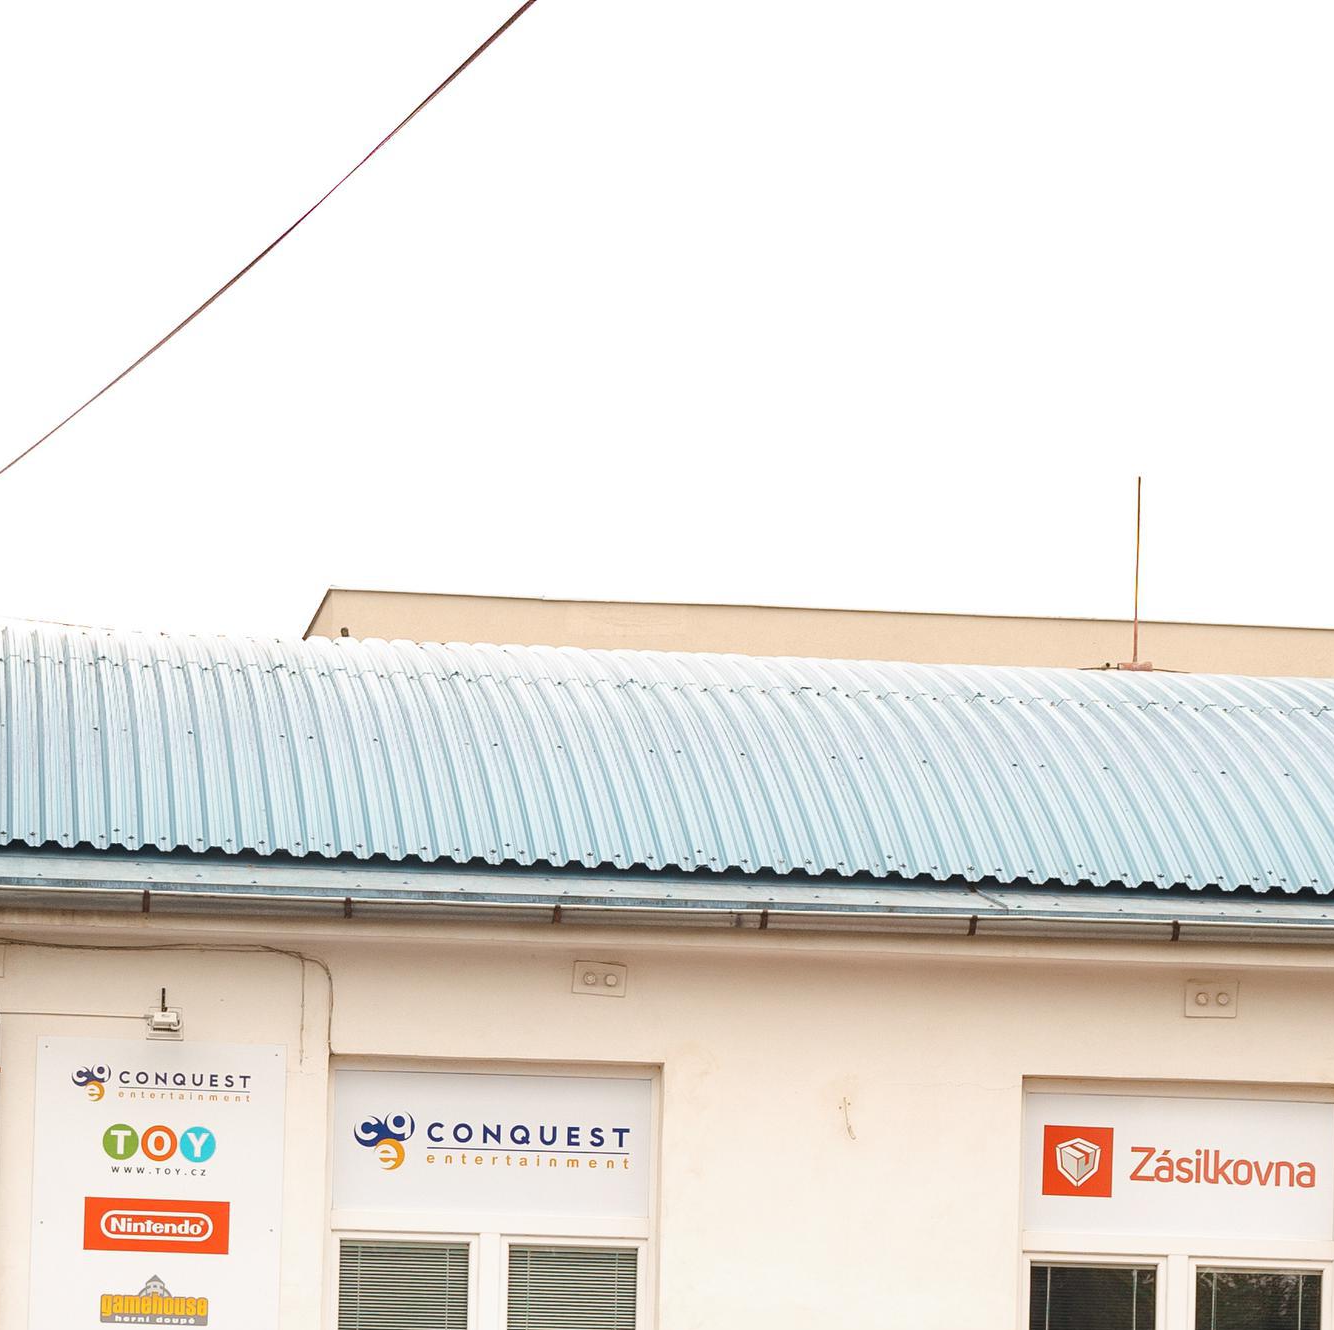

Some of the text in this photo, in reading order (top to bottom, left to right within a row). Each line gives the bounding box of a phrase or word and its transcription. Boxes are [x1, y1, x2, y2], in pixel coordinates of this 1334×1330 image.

[119, 1071, 251, 1088] CONQUEST
[118, 1091, 250, 1102] entertainment
[109, 1128, 211, 1159] TOY
[427, 1122, 630, 1148] CONQUEST
[426, 1153, 629, 1169] entertainment
[1129, 1146, 1316, 1188] Zásilkovna
[111, 1166, 206, 1176] WWW.TOY.CZ
[110, 1217, 203, 1235] Nintendo
[101, 1292, 208, 1317] gamehouse
